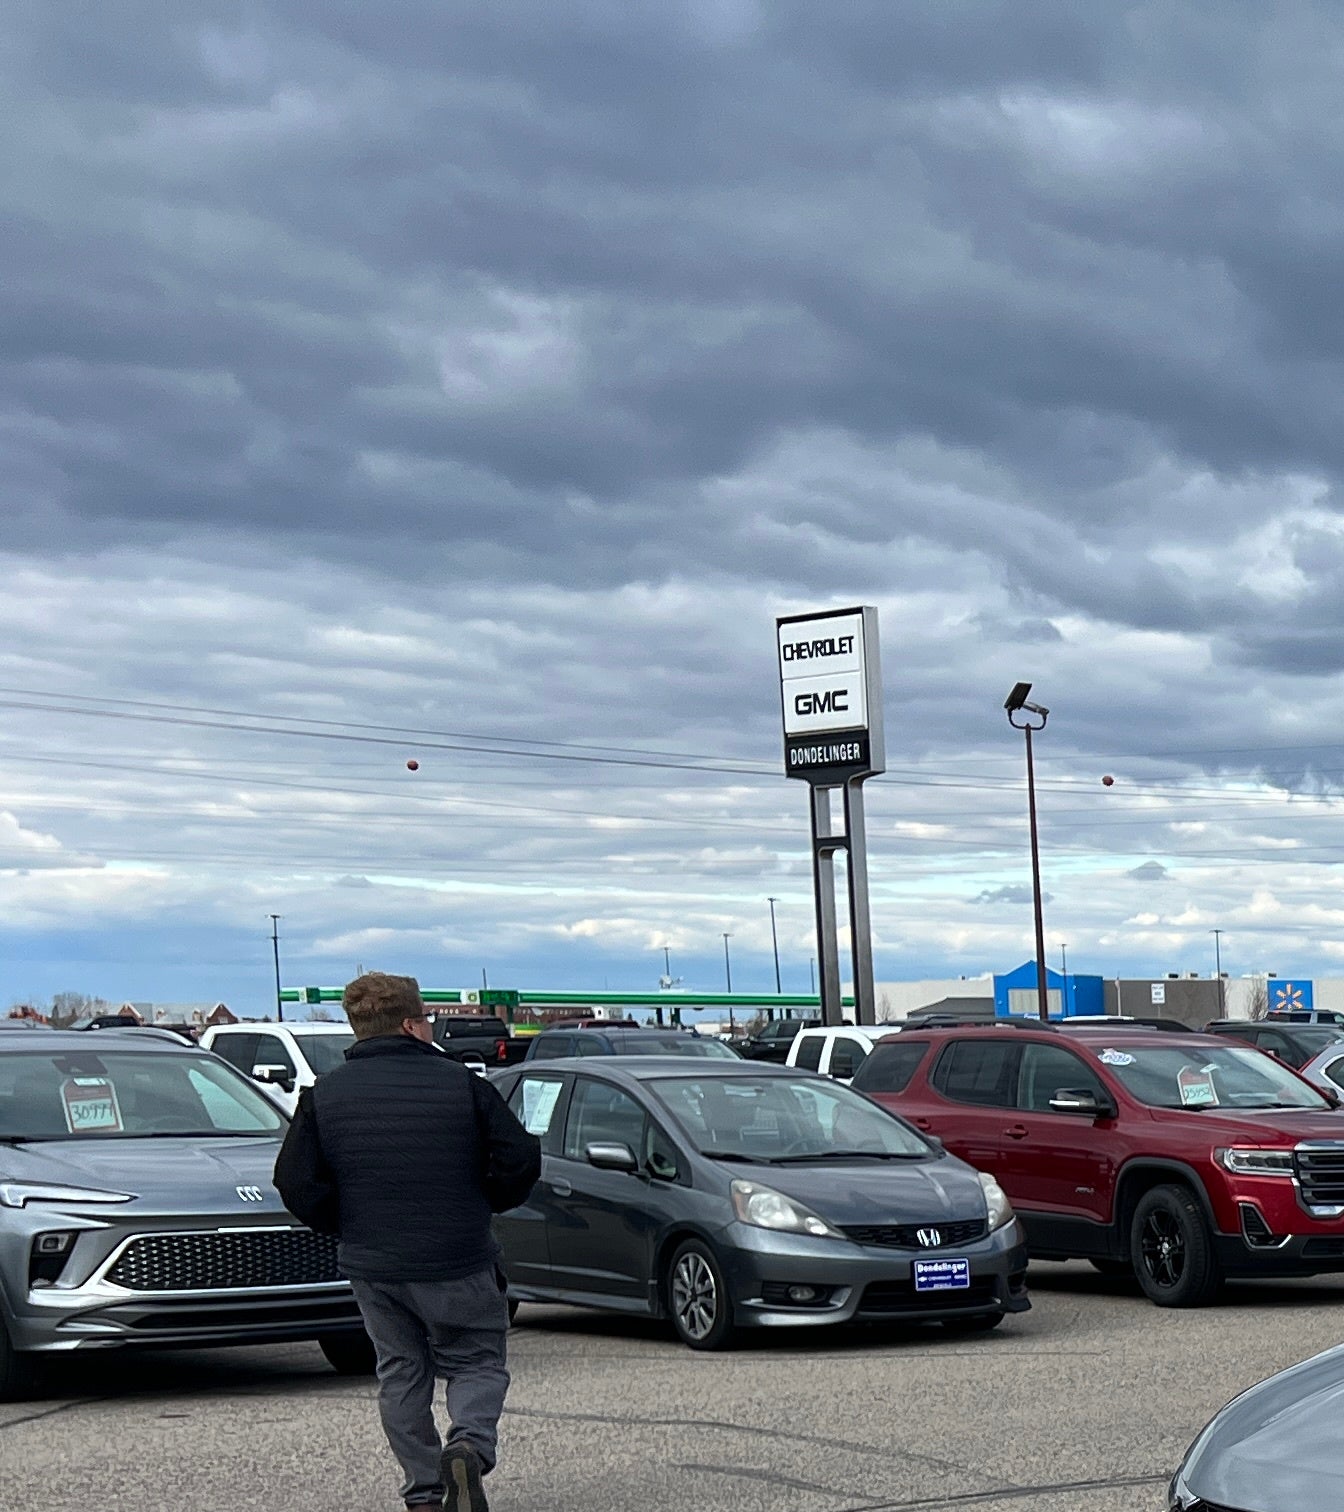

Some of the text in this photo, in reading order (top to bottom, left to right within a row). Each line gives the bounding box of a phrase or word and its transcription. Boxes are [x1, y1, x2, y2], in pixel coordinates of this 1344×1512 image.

[782, 635, 854, 661] CHEVROLET
[794, 689, 849, 715] GMC
[791, 743, 861, 766] DONDELINGER
